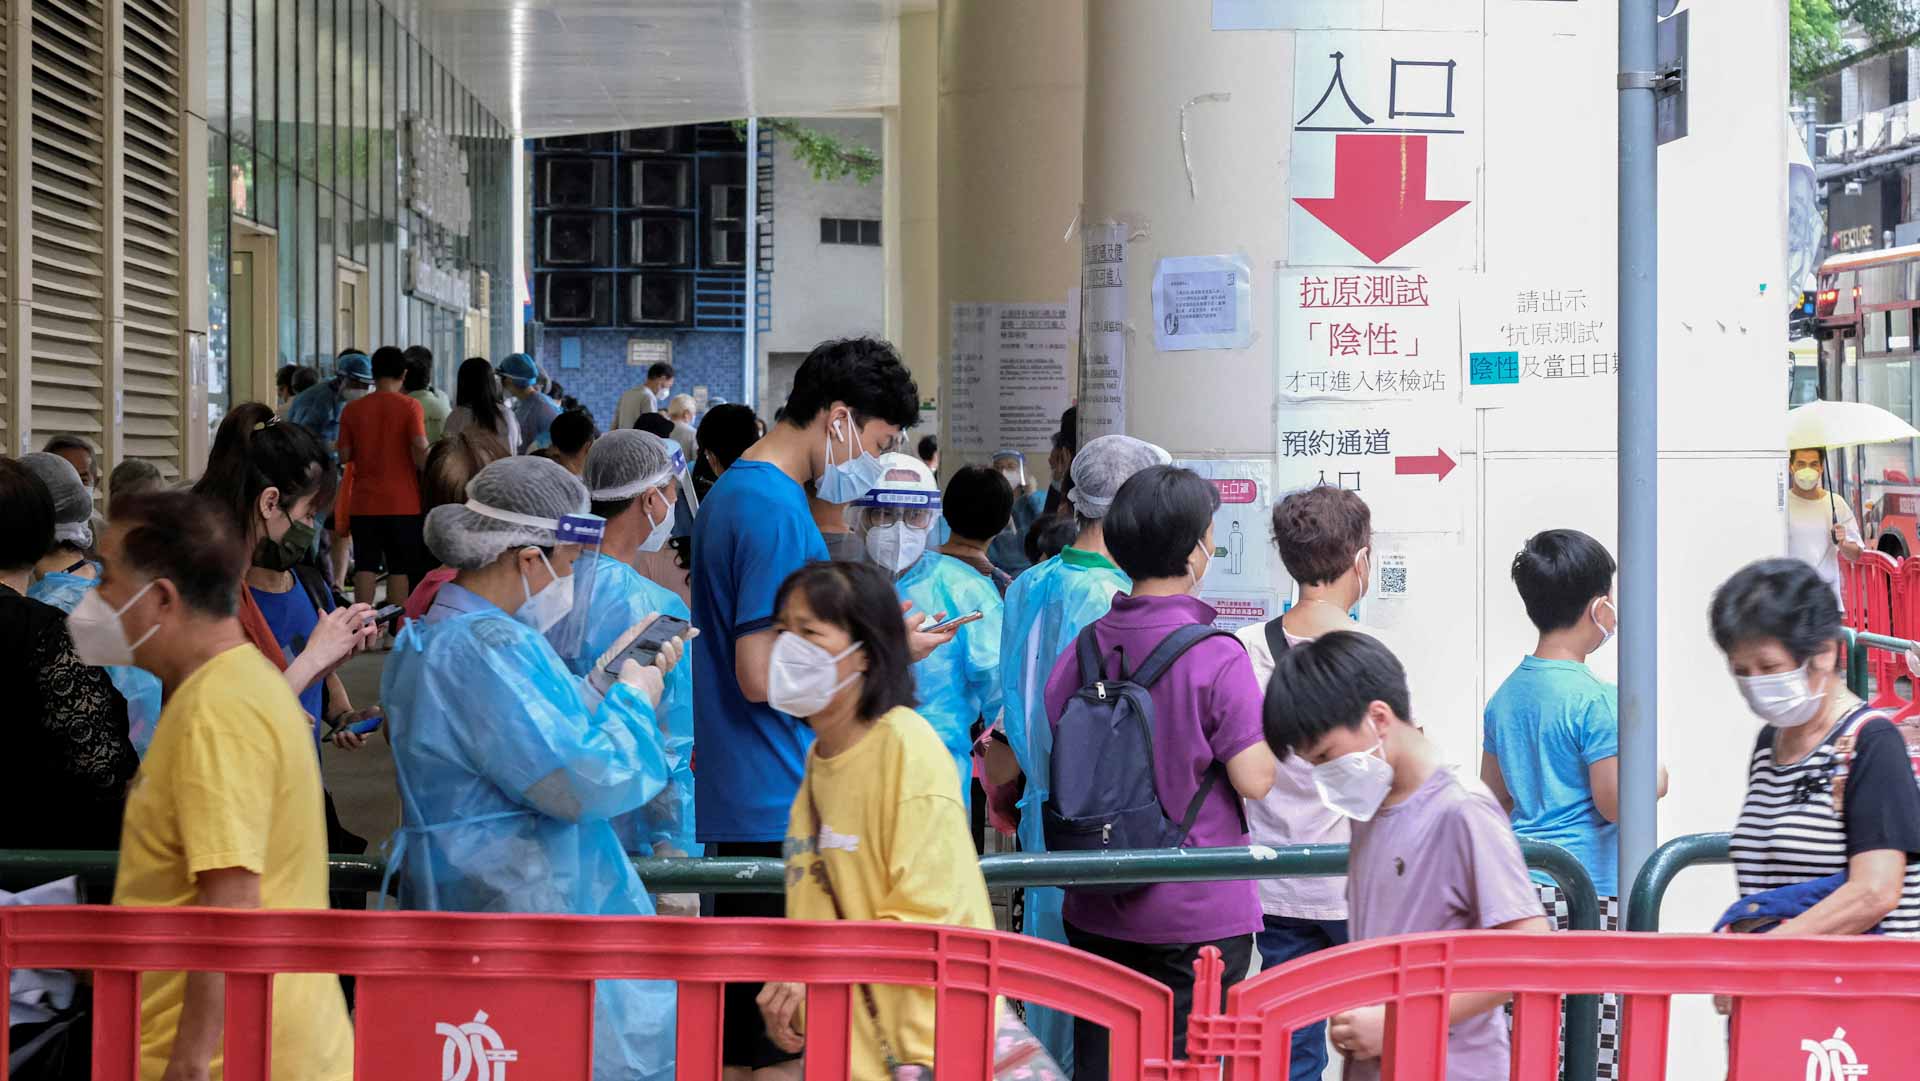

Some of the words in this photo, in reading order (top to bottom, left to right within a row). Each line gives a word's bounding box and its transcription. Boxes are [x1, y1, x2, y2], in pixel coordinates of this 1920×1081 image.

[1296, 50, 1457, 126] 入口
[1838, 224, 1873, 251] TEXTURE
[1299, 273, 1429, 307] 抗原測試
[1516, 289, 1588, 314] 請出示
[1306, 321, 1422, 357] 「陰性」
[1285, 369, 1446, 393] 才可進入核檢站
[1281, 429, 1392, 457] 預約通道
[1316, 470, 1361, 491] 入口
